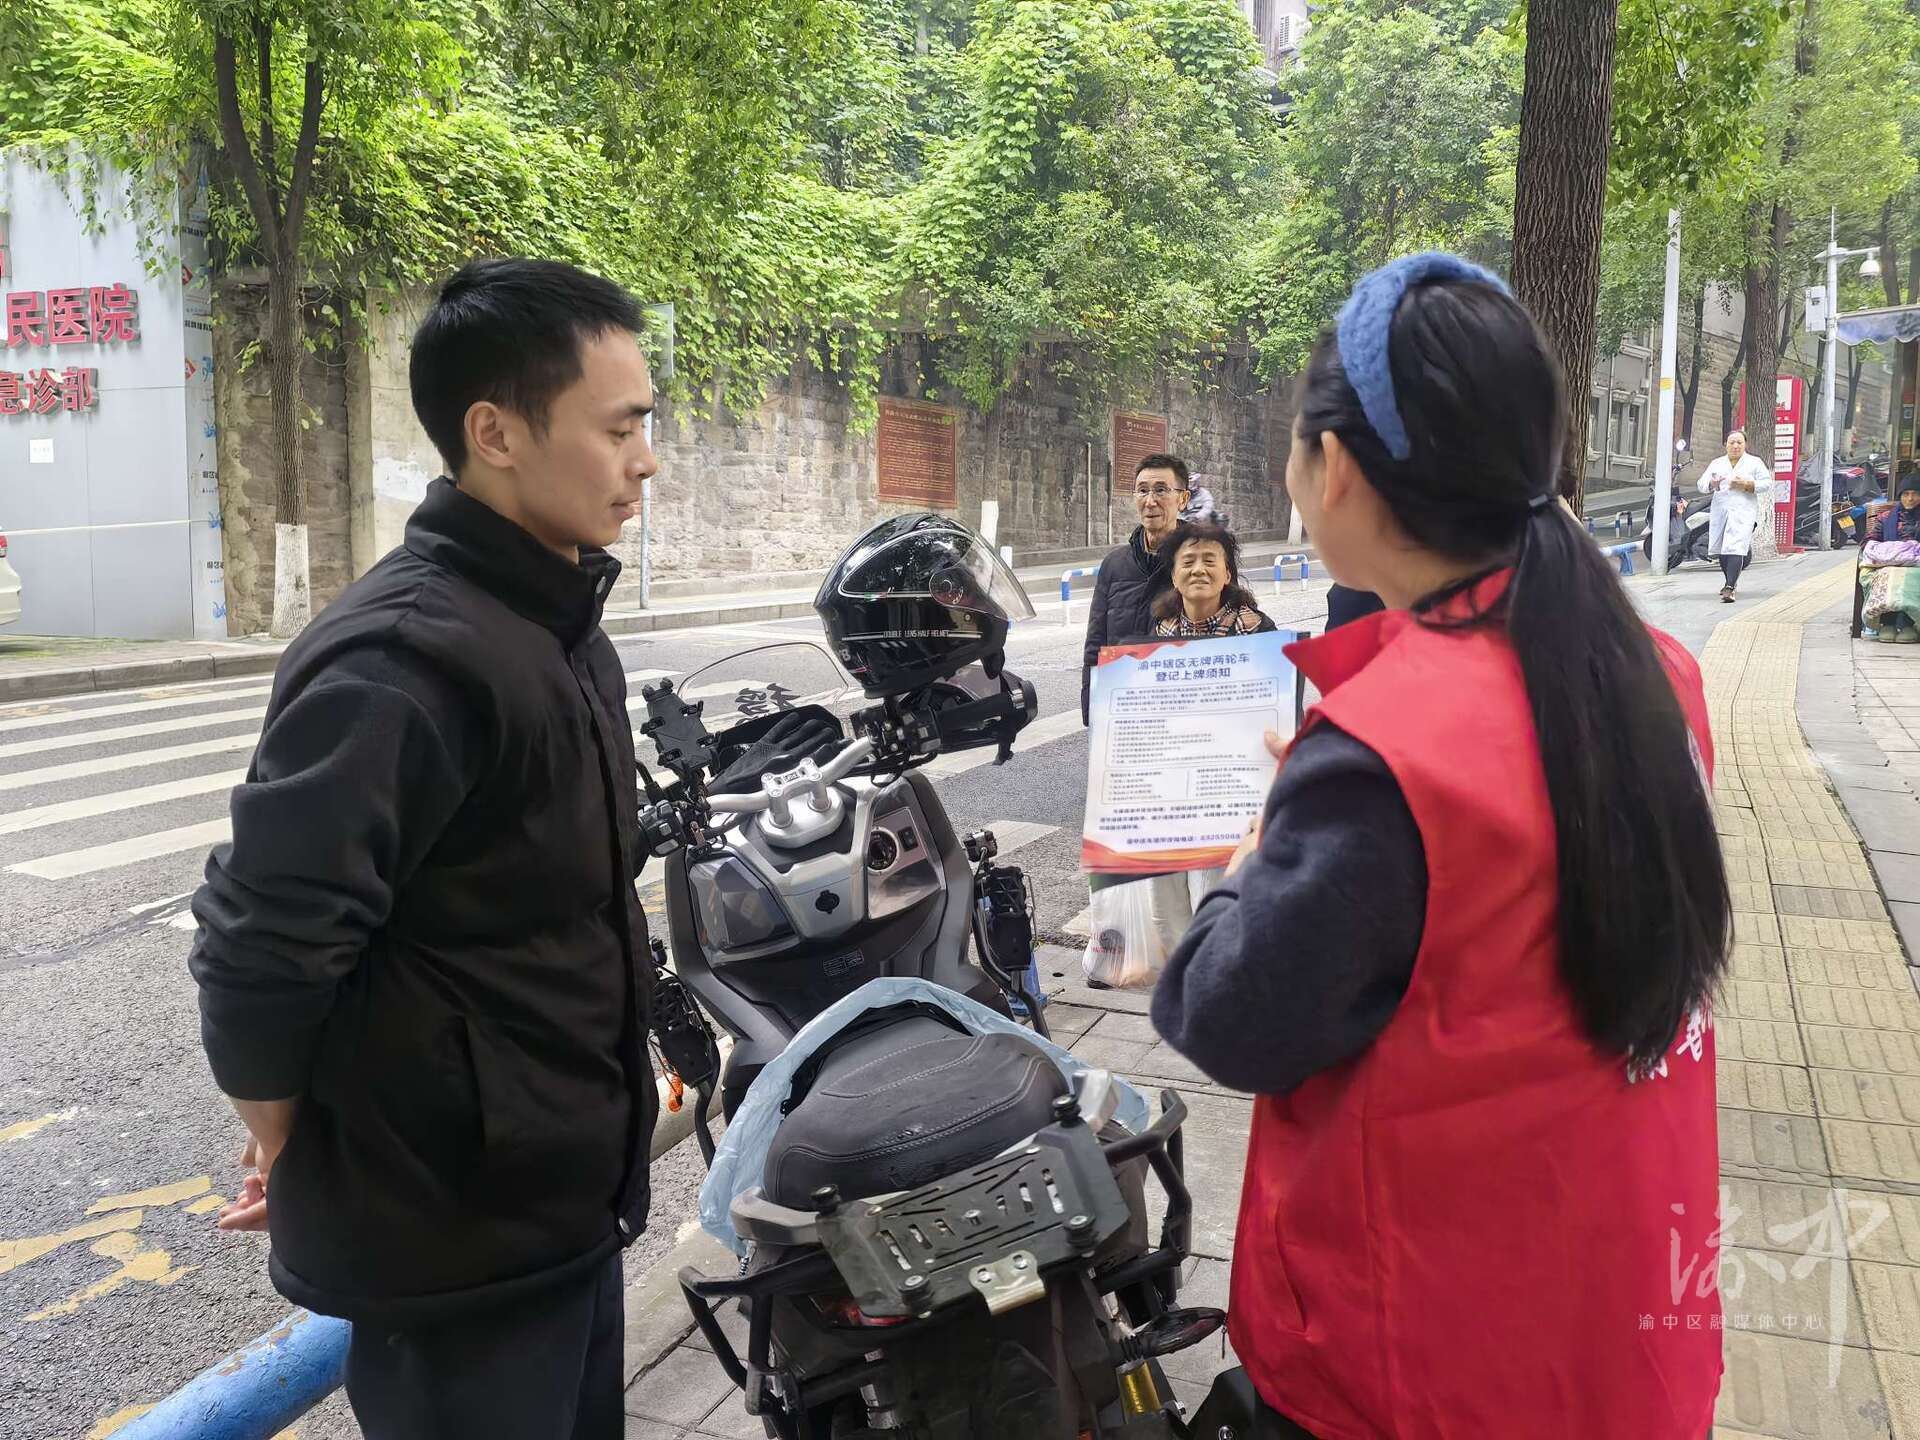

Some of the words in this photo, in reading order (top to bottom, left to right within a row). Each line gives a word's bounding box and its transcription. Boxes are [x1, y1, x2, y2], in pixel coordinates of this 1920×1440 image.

[6, 282, 140, 347] 民医院
[1155, 667, 1231, 682] 登记上牌须知
